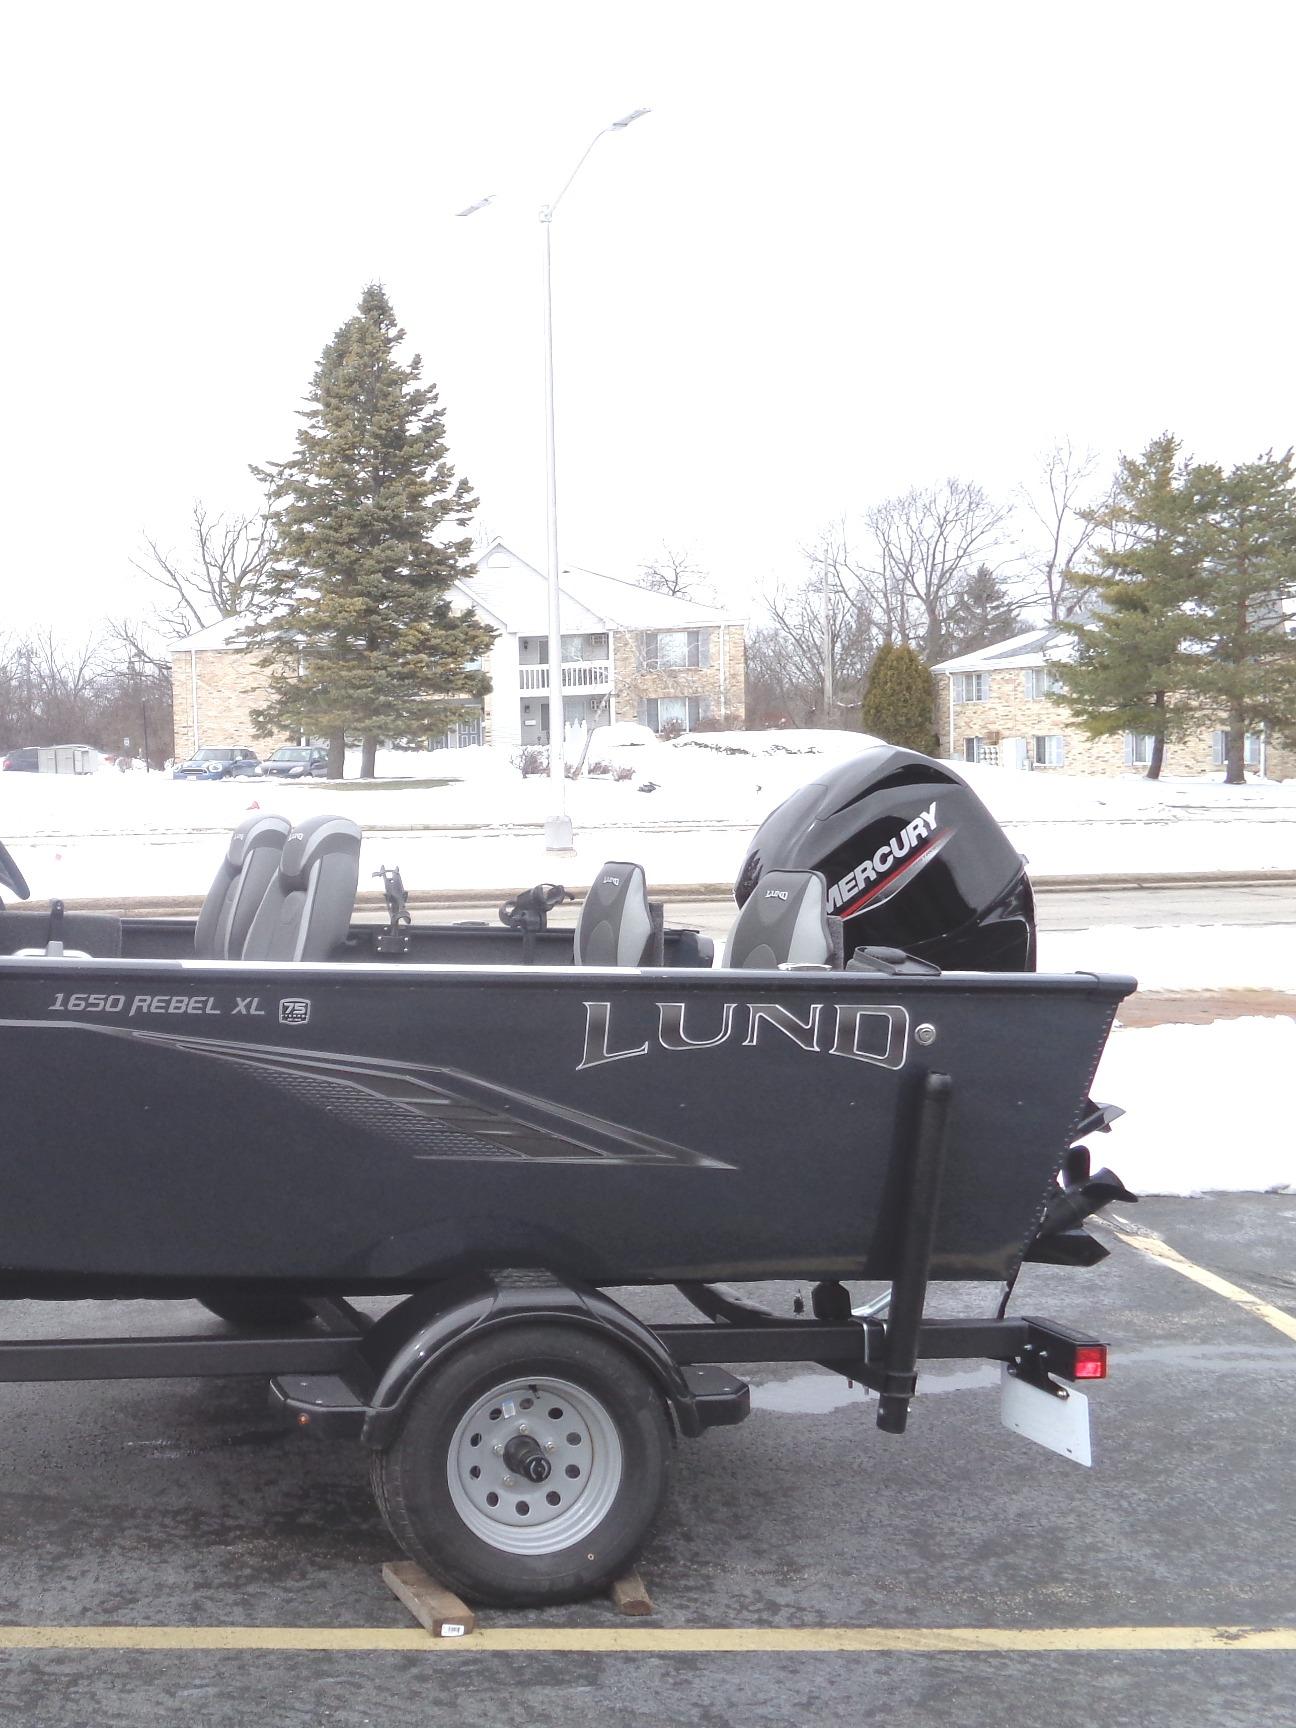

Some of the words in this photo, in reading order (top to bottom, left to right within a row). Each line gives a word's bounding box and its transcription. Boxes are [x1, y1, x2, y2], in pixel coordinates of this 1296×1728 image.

[826, 801, 937, 914] MERCURY
[48, 993, 126, 1012] 1650
[129, 995, 221, 1017] REBEL
[231, 997, 266, 1015] XL
[283, 1002, 306, 1014] 75
[575, 1001, 910, 1070] LUND
